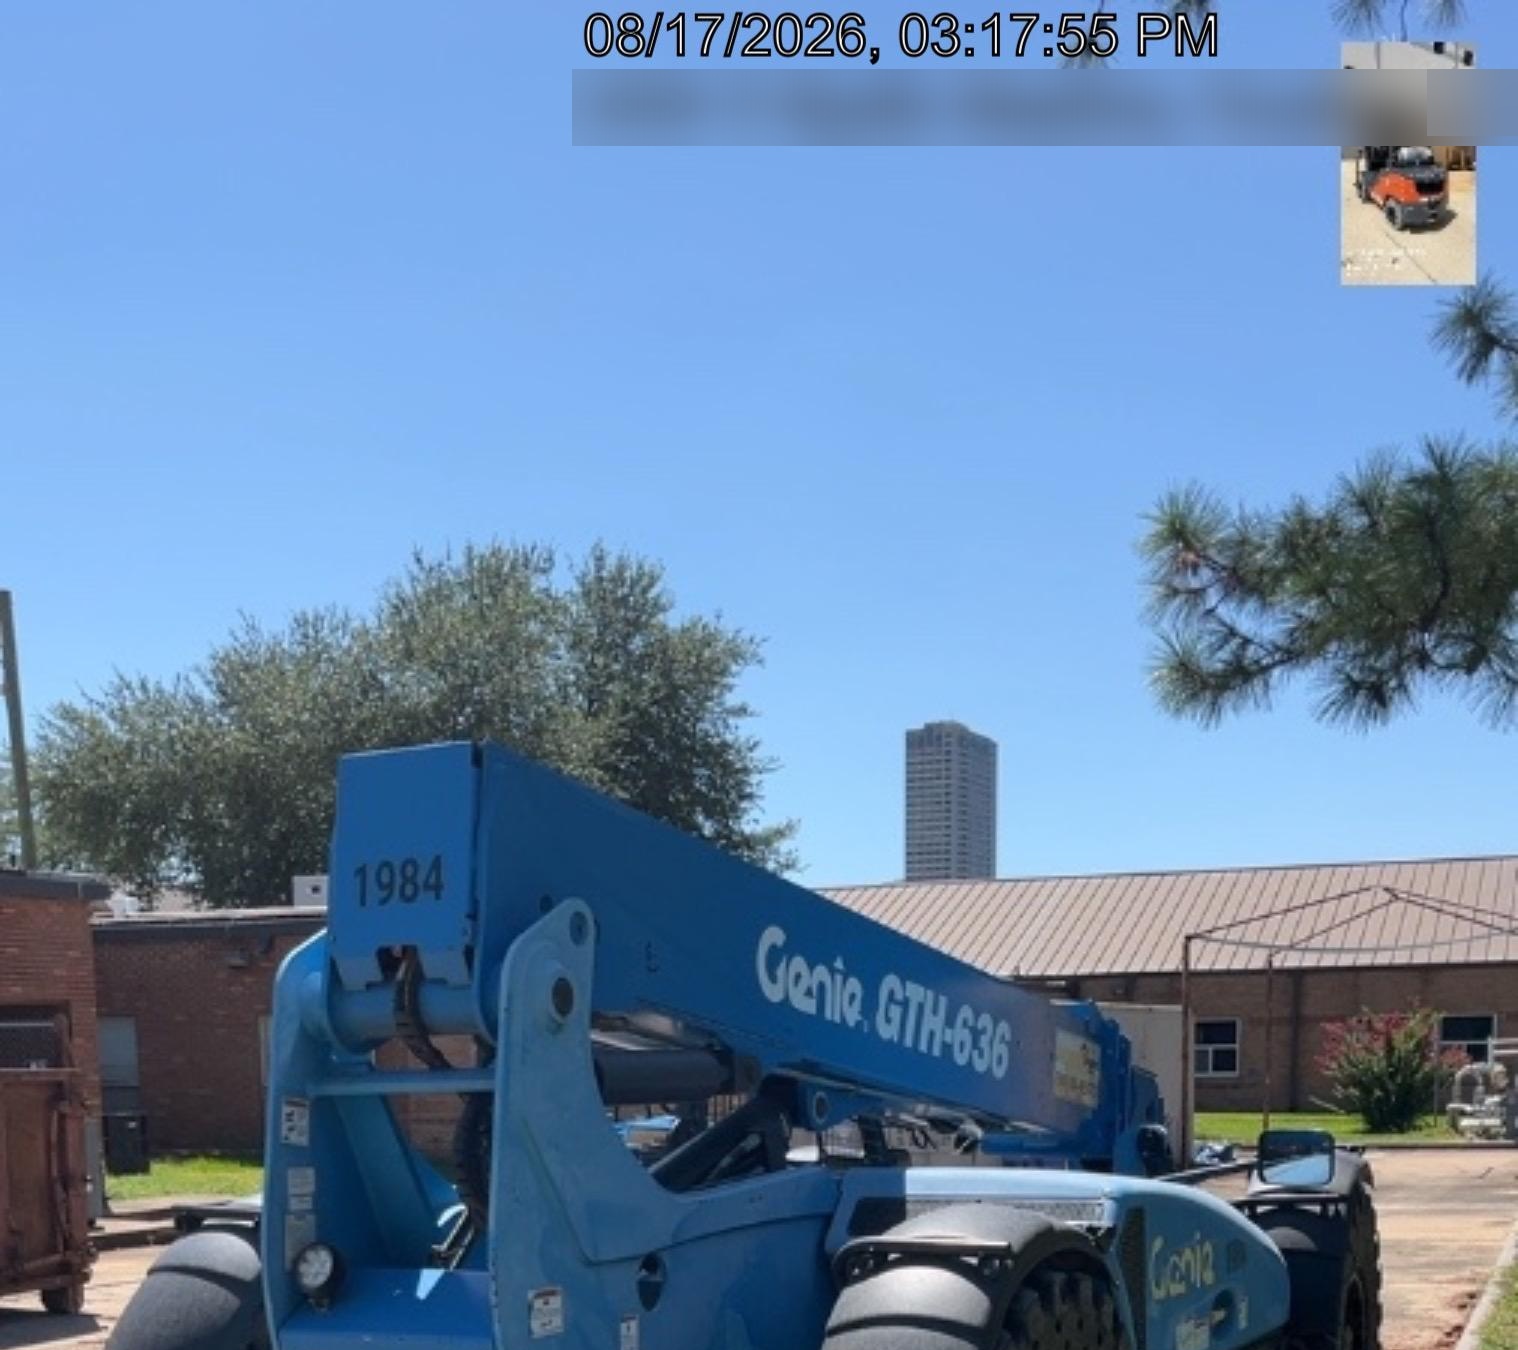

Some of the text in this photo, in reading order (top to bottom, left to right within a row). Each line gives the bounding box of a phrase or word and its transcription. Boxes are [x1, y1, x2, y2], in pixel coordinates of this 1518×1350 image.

[354, 855, 445, 908] 1984
[756, 926, 863, 1028] Genie
[876, 973, 1012, 1080] GTH-636
